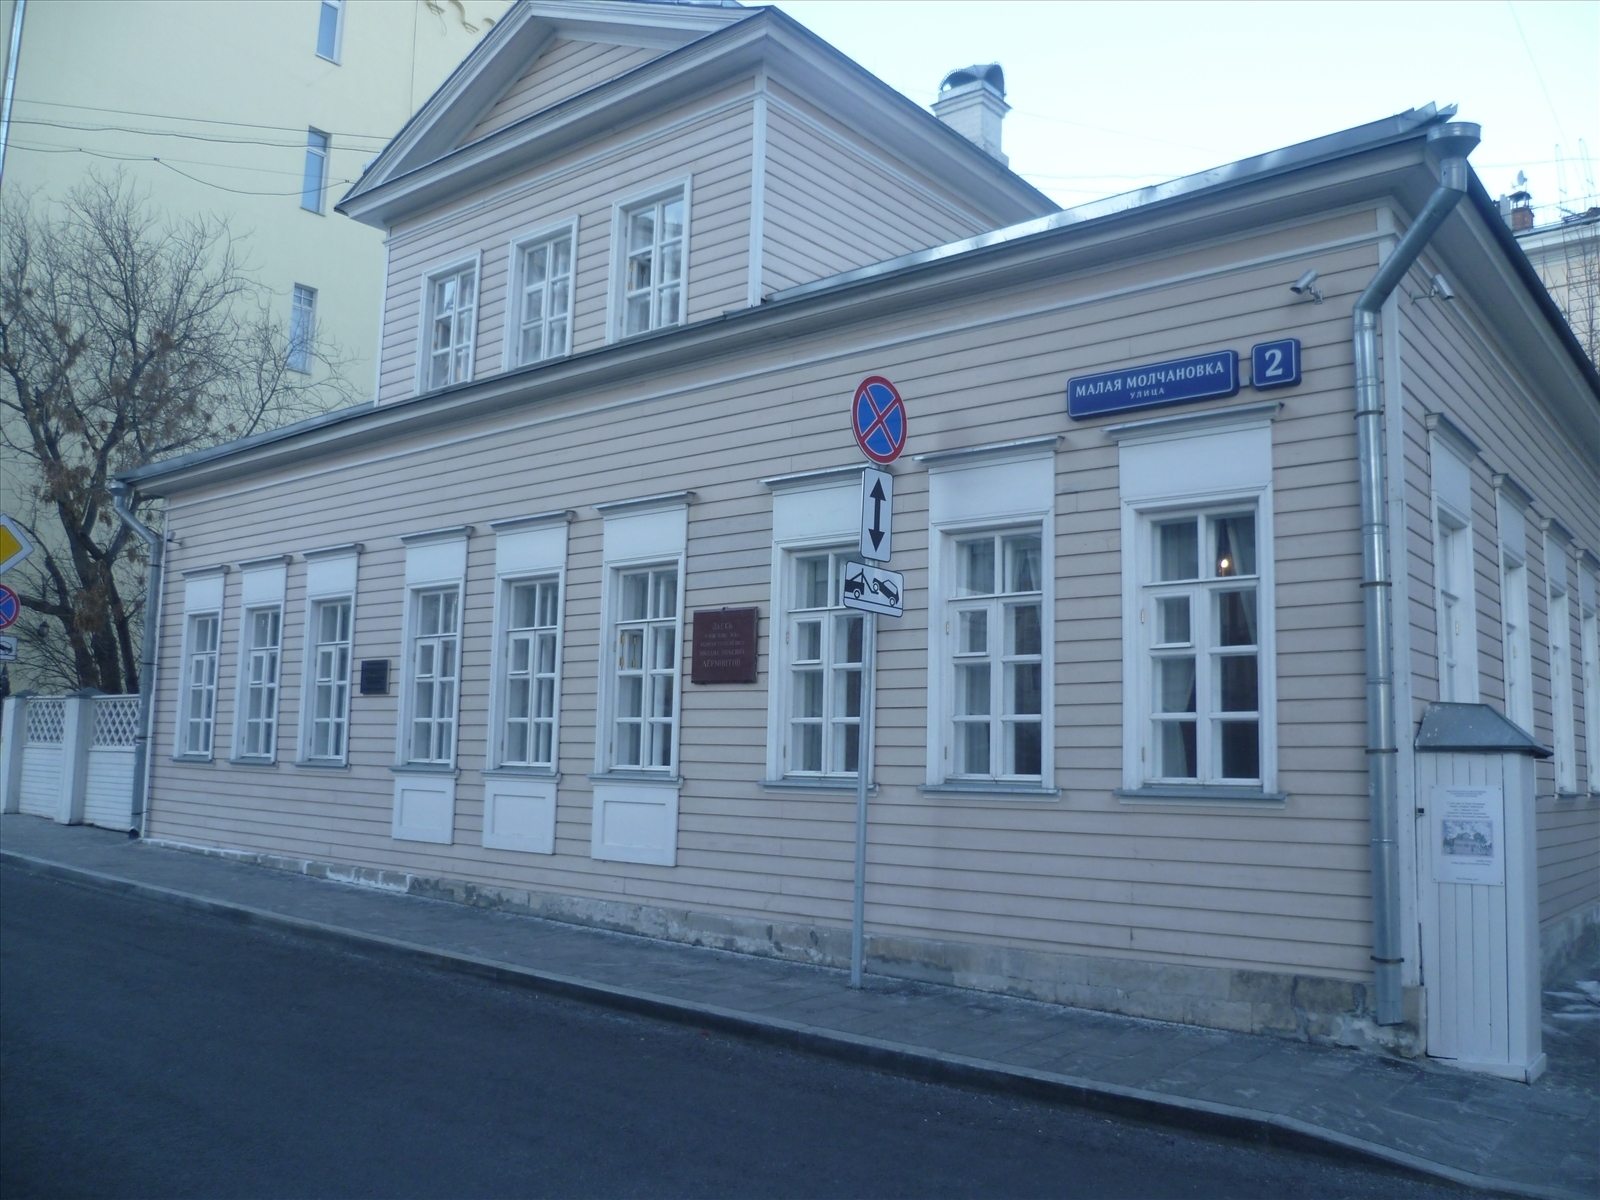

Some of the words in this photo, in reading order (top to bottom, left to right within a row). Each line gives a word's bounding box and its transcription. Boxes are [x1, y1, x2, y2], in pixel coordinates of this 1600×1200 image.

[1264, 348, 1284, 378] 2
[1075, 378, 1122, 398] МАЛАЯ
[1126, 361, 1224, 390] МОЛЧАНОВКА
[1129, 388, 1165, 400] УЛИЦА
[703, 658, 741, 668] ЛЕРМОНТОВ
